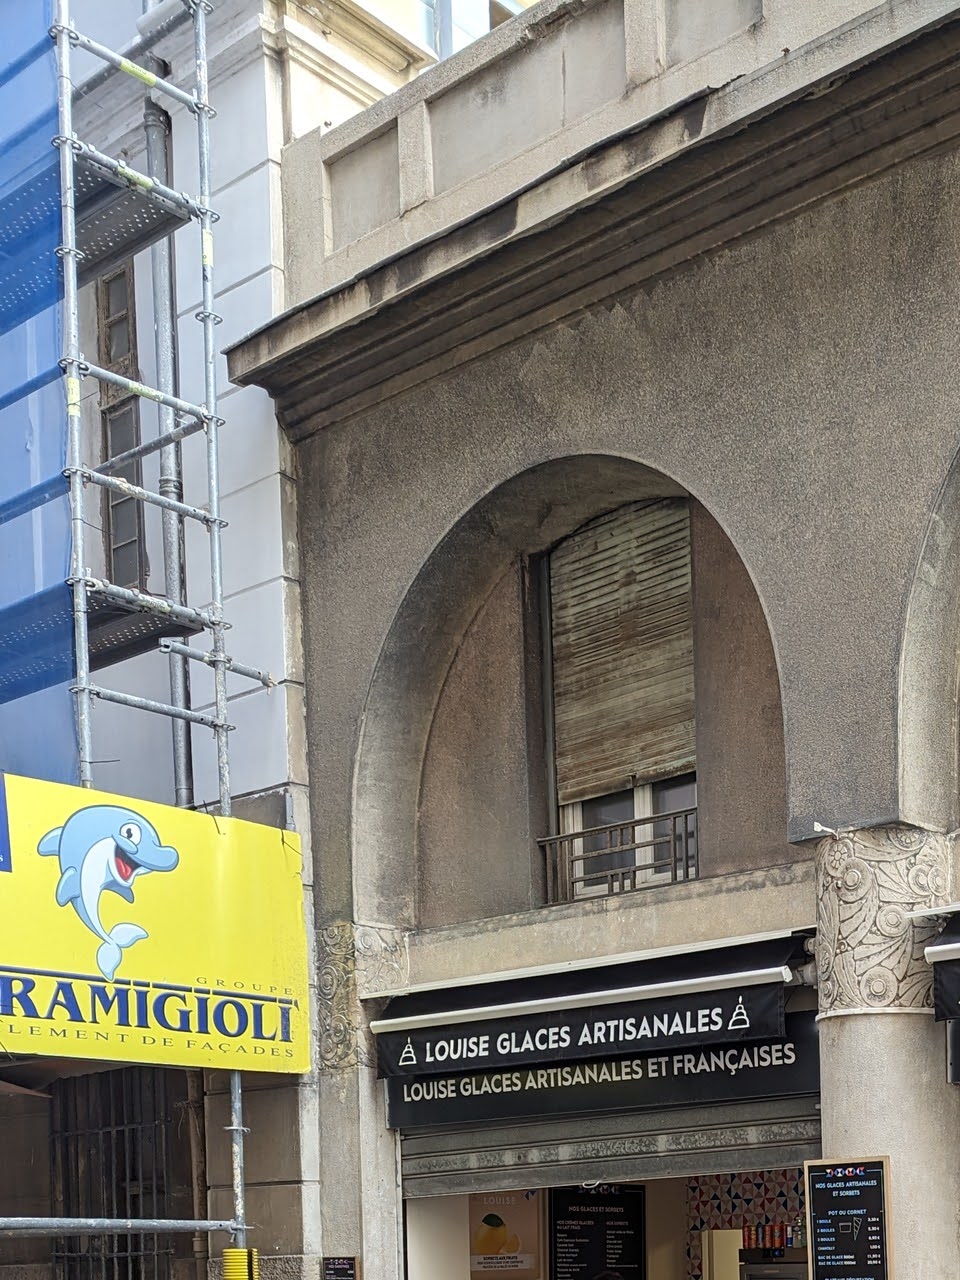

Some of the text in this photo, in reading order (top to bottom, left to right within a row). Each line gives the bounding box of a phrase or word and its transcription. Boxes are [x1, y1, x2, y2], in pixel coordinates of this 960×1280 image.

[196, 976, 294, 995] GROUPE
[425, 1007, 723, 1062] LOUISE GLACES ARTISANALES
[142, 1035, 174, 1048] DE
[187, 1039, 294, 1058] FAÇADES
[403, 1043, 796, 1102] LOUISE GLACES ARTISANALES ET FRANÇAISES
[483, 1196, 516, 1205] LOUISE
